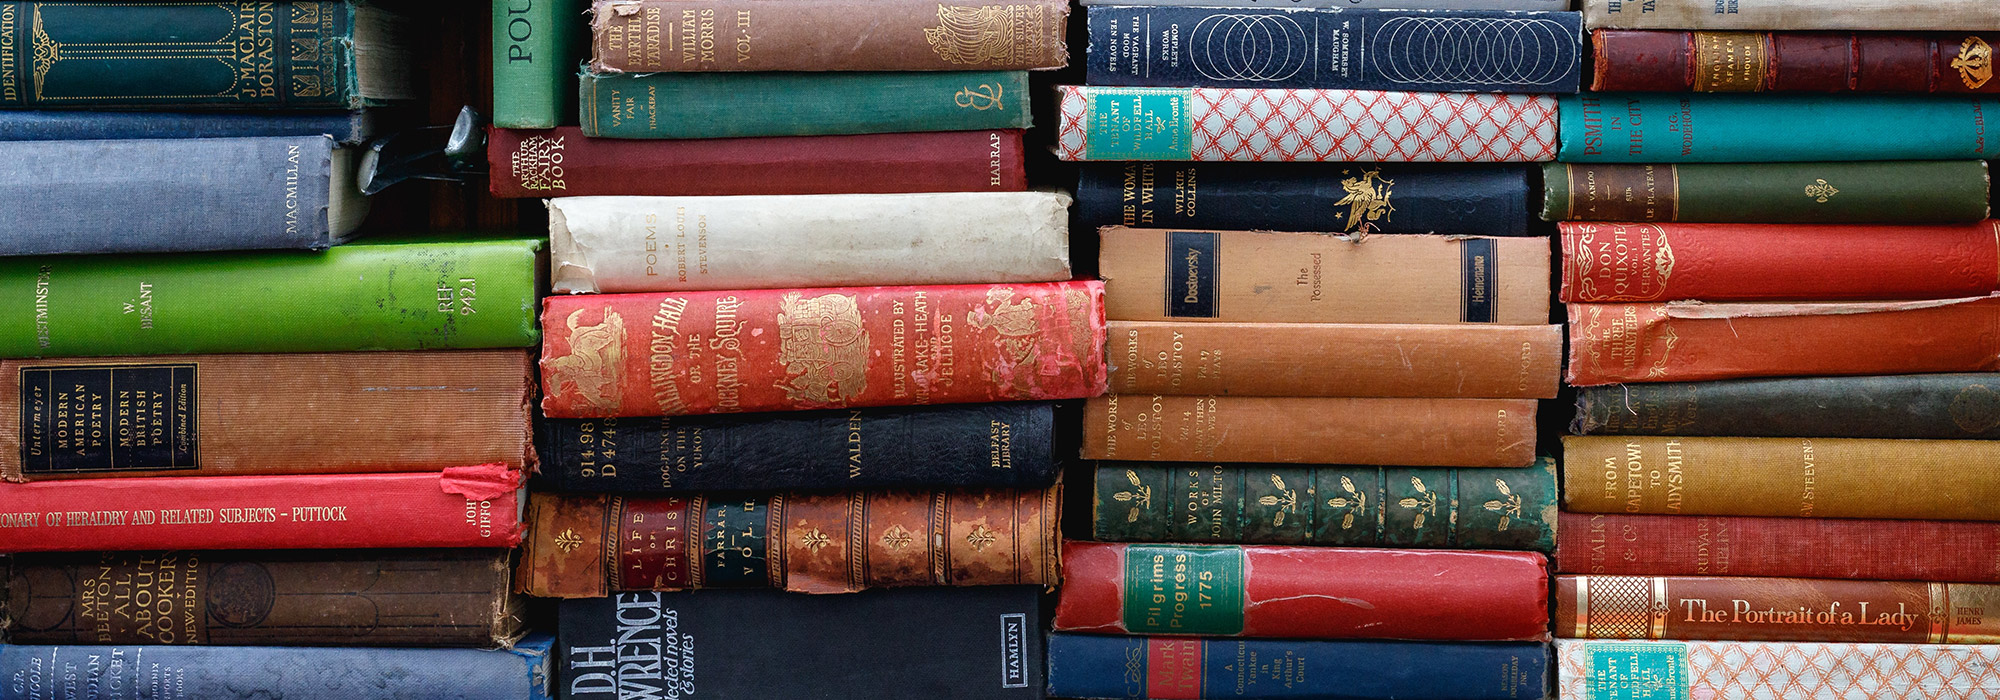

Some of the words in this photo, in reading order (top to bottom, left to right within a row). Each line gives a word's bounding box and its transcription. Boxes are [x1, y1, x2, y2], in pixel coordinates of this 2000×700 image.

[608, 25, 623, 51] THE
[646, 7, 661, 67] PARADISE
[682, 9, 696, 63] WILLIAM
[700, 8, 715, 63] MORRIS
[1015, 4, 1025, 41] SILVER
[1110, 18, 1118, 37] TEN
[1132, 15, 1140, 34] THE
[2, 4, 16, 101] IDENTIFICATION
[258, 1, 275, 97] BORASTON
[1015, 43, 1025, 65] THE
[1109, 38, 1117, 72] NOVELS
[1131, 35, 1139, 76] VAGRANT
[1162, 29, 1170, 61] WORKS
[1171, 23, 1179, 68] COMPLETE
[1332, 29, 1340, 72] MAUGHAM
[1341, 32, 1349, 78] SOMERSET
[1711, 35, 1721, 87] ENGLISH
[1726, 39, 1735, 83] SEAMEN
[1743, 45, 1752, 81] FROUDE
[611, 89, 621, 127] VANITY
[626, 97, 635, 119] FAIR
[648, 85, 657, 130] THACKERAY
[1099, 112, 1108, 136] THE
[1111, 100, 1120, 148] TENANT
[1122, 116, 1131, 132] OF
[1133, 95, 1142, 151] WILDFELL
[1144, 110, 1153, 140] HALL
[1581, 97, 1603, 156] PSMITH
[1611, 116, 1622, 131] IN
[1627, 97, 1642, 127] CITY
[1679, 98, 1693, 156] WODEHOUSE
[990, 133, 1001, 186] HARRAP
[1169, 128, 1179, 151] Anne
[1628, 129, 1643, 156] THE
[512, 151, 521, 177] THE
[520, 139, 532, 190] ARTHUR
[529, 136, 540, 190] RACKHAM
[538, 136, 552, 190] FAIRY
[551, 136, 567, 190] BOOK
[1141, 163, 1154, 205] WHITE
[286, 144, 300, 234] MACMILLAN
[1175, 171, 1185, 215] WILKIE
[1187, 168, 1197, 217] COLLINS
[676, 206, 686, 238] LOUIS
[1123, 205, 1135, 227] THE
[1141, 209, 1154, 224] IN
[645, 213, 658, 276] POEMS
[677, 242, 687, 283] ROBERT
[698, 214, 708, 274] STEVENSON
[1599, 241, 1612, 279] DON
[1614, 226, 1629, 295] QUIXOTE
[1640, 227, 1652, 294] CERVANTES
[459, 277, 476, 315] 942.1
[1184, 247, 1201, 304] Dostoevsky
[1296, 268, 1309, 286] The
[1310, 253, 1322, 302] Possessed
[1472, 255, 1485, 303] Heinemann
[36, 265, 51, 349] WESTMINSTER
[123, 298, 135, 315] W.
[141, 282, 153, 329] BESANT
[437, 283, 454, 312] REF
[652, 297, 688, 337] HALL
[893, 299, 904, 315] BY
[687, 333, 702, 359] THE
[709, 295, 748, 361] SQUIRE
[1602, 328, 1611, 350] THE
[1611, 318, 1625, 360] THREE
[1623, 305, 1638, 371] MUSKETEERS
[893, 319, 906, 398] ILLUSTRATED
[939, 313, 954, 387] JELLICOE
[1128, 329, 1139, 371] WORKS
[1142, 357, 1154, 369] of
[1158, 351, 1168, 377] LEO
[1200, 350, 1209, 361] 17
[1518, 342, 1531, 391] OXFORD
[689, 364, 701, 384] OR
[152, 391, 163, 445] POETRY
[178, 383, 187, 411] Edition
[1108, 393, 1118, 433] WORKS
[1196, 398, 1204, 425] THEN
[31, 385, 43, 456] Untermeyer
[58, 391, 68, 449] MODERN
[75, 383, 85, 456] AMERICAN
[91, 392, 102, 447] POETRY
[119, 390, 130, 447] MODERN
[136, 390, 146, 447] BRITISH
[178, 413, 188, 453] Combined
[602, 417, 617, 459] 4748
[676, 427, 686, 451] THE
[1121, 419, 1133, 431] of
[1137, 412, 1147, 440] LEO
[1151, 393, 1163, 459] TOLSTOY
[1495, 409, 1507, 460] OXFORD
[580, 422, 595, 478] 914.98
[676, 456, 687, 473] ON
[693, 427, 703, 468] YUKON
[848, 410, 861, 479] WALDEN
[990, 419, 1001, 468] BELFAST
[1001, 422, 1011, 469] LIBRARY
[1107, 434, 1118, 457] THE
[602, 463, 617, 478] D
[1605, 456, 1617, 500] FROM
[1650, 470, 1661, 489] TO
[1802, 439, 1815, 500] STEEVENS
[46, 512, 63, 527] OF
[66, 510, 128, 527] HERALDRY
[132, 510, 155, 525] AND
[160, 508, 214, 525] RELATED
[219, 507, 276, 523] SUBJECTS
[292, 506, 348, 522] PUTTOCK
[1187, 470, 1199, 525] WORKS
[1201, 491, 1209, 506] OF
[631, 512, 644, 570] LIFE
[649, 534, 656, 549] OF
[665, 497, 680, 581] CHRIST
[717, 504, 727, 568] FARRAR.
[1211, 508, 1222, 538] JOHN
[1591, 513, 1605, 574] STALKY
[742, 521, 754, 576] VOL.
[1623, 548, 1637, 561] &
[1716, 517, 1730, 574] KIPLING
[81, 578, 96, 617] MRS
[114, 573, 131, 619] ALL
[135, 555, 155, 639] ABOUT
[1147, 554, 1166, 626] Pilgrims
[1170, 554, 1188, 628] Progress
[1199, 570, 1213, 609] 1775
[662, 607, 679, 656] novels
[1679, 598, 1728, 623] The
[1731, 599, 1814, 624] Portrait
[1816, 601, 1840, 625] of
[1841, 610, 1855, 625] a
[1858, 601, 1919, 632] Lady
[1955, 617, 1982, 625] JAMES
[1957, 607, 1985, 616] HENRY
[679, 633, 695, 681] stories
[1008, 622, 1020, 679] HAMLYN
[1159, 642, 1175, 687] Mark
[1178, 640, 1195, 693] Twain
[1247, 651, 1257, 685] Yankee
[1260, 664, 1269, 674] in
[1272, 658, 1283, 680] King
[1284, 650, 1293, 689] Arthur's
[1296, 657, 1305, 683] Court
[13, 670, 25, 693] C.R.
[679, 680, 695, 695] &
[1597, 669, 1606, 692] THE
[1620, 673, 1629, 689] OF
[1641, 667, 1651, 697] HALL
